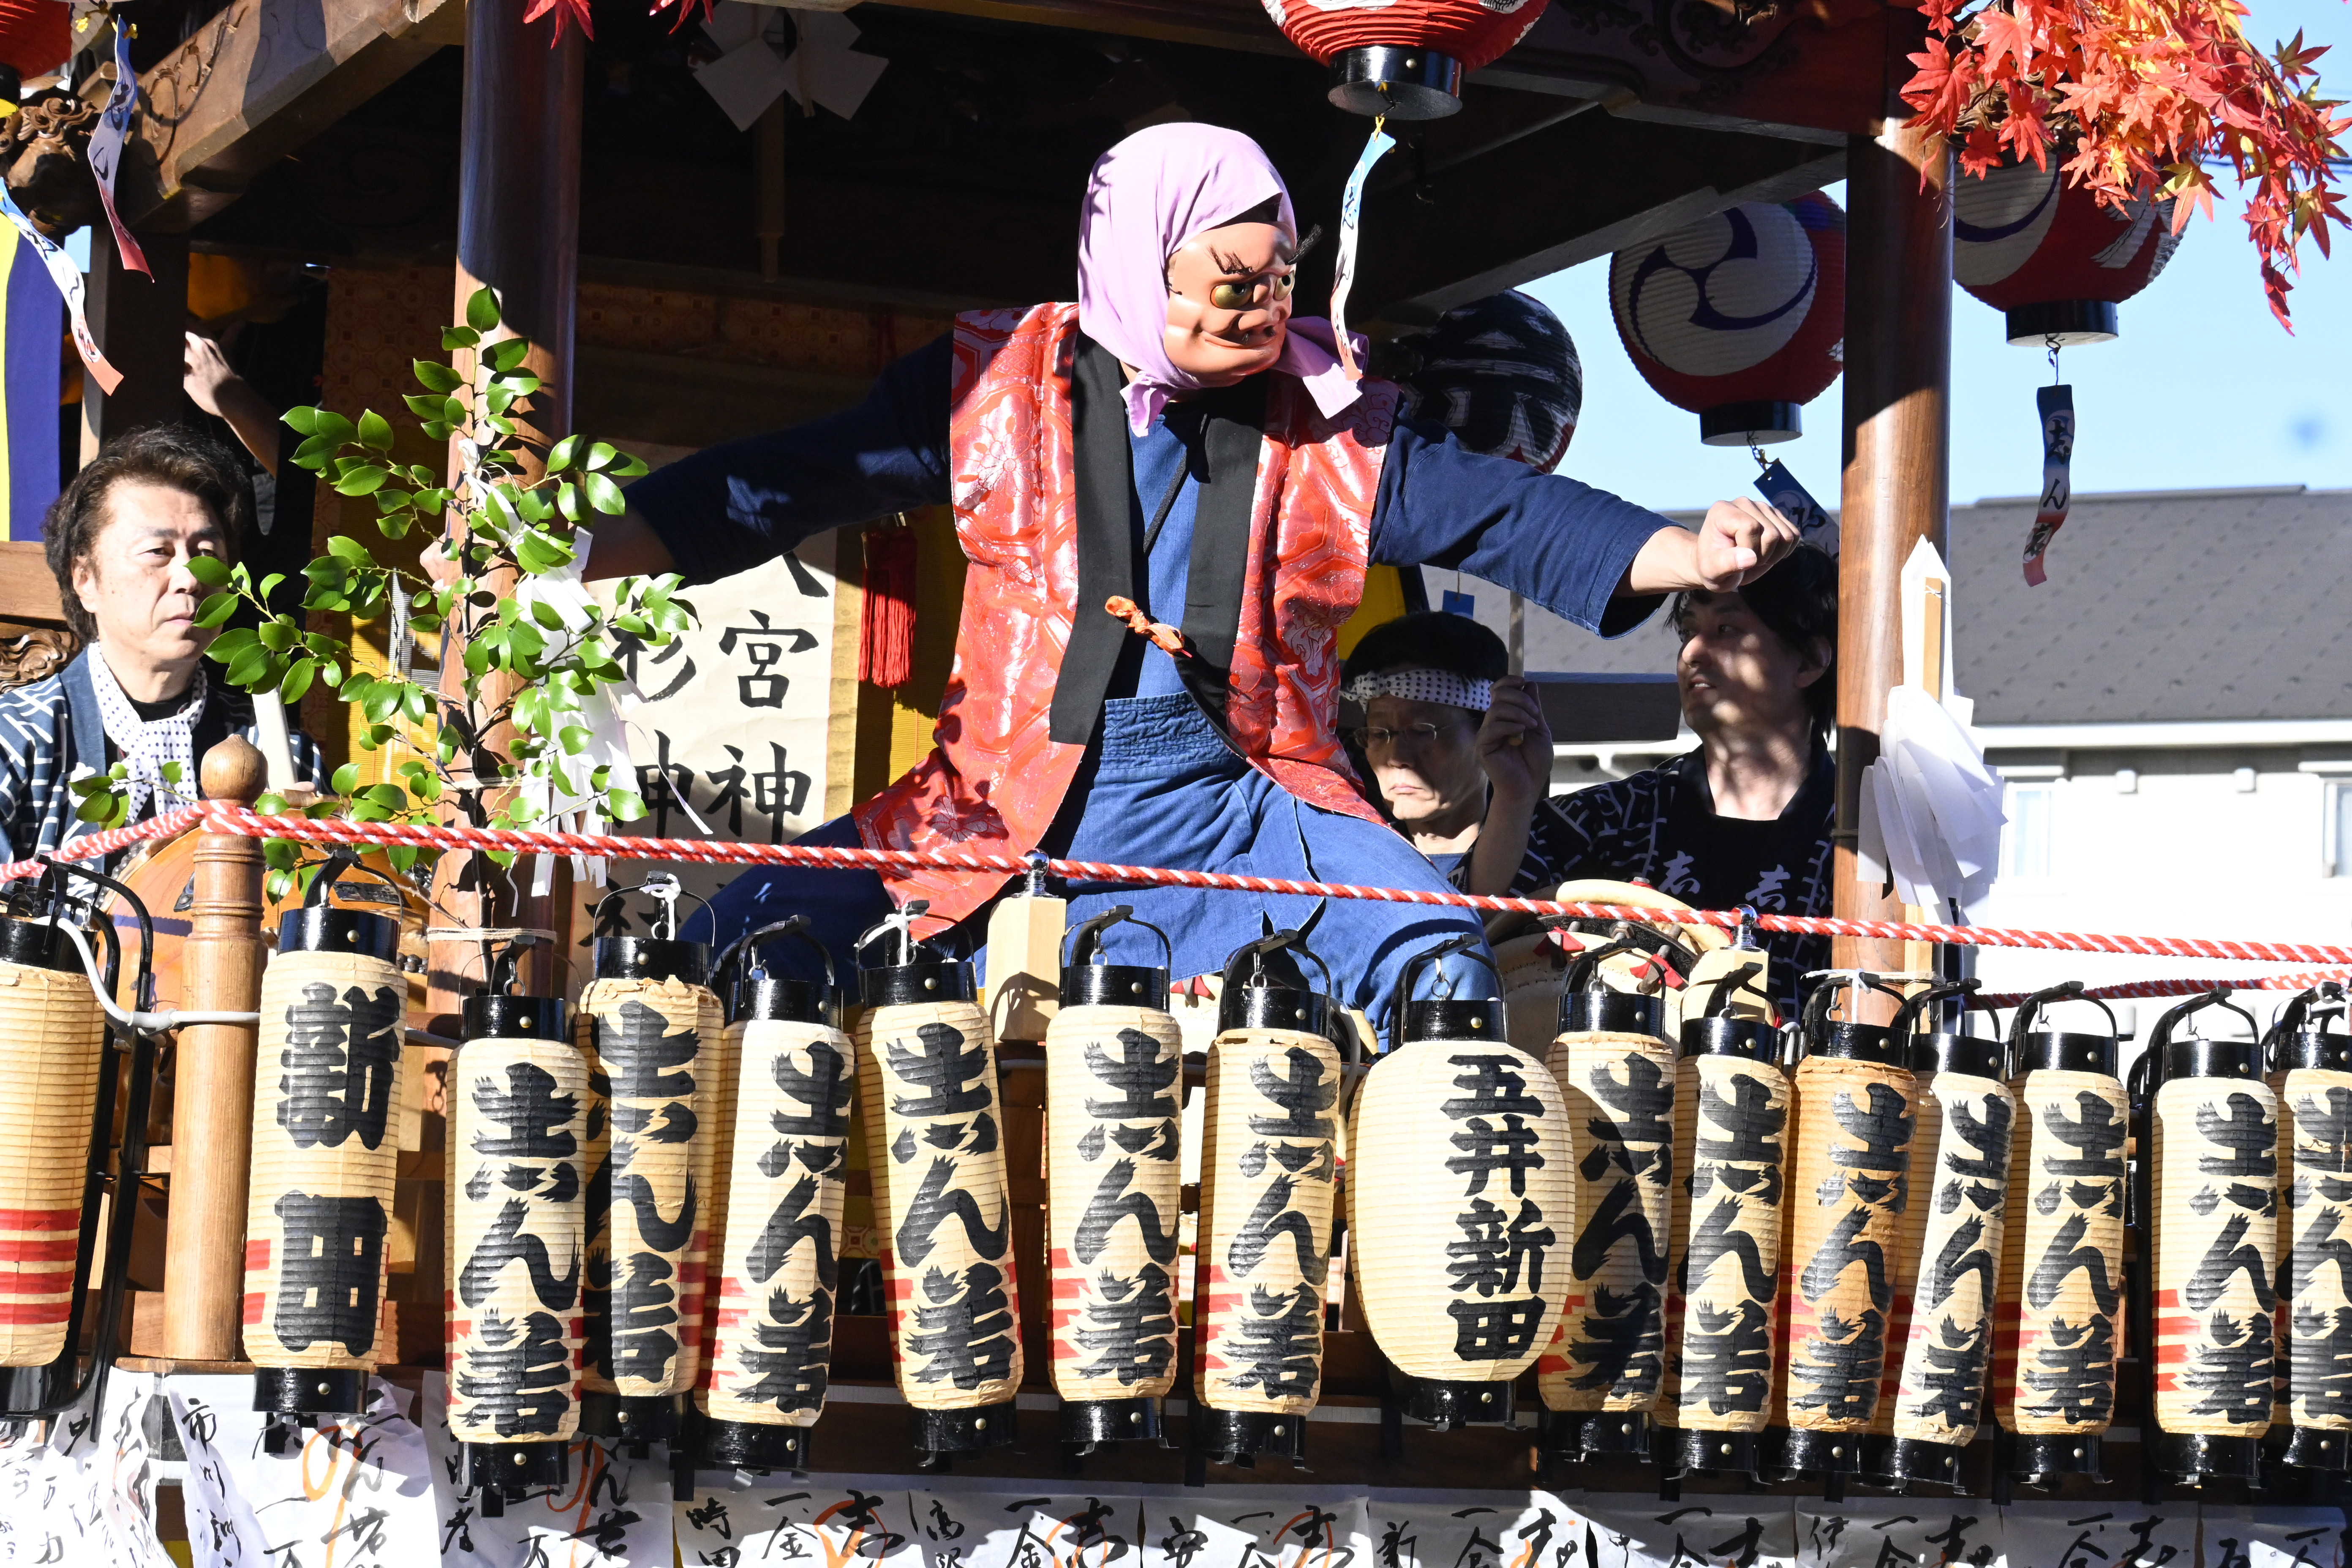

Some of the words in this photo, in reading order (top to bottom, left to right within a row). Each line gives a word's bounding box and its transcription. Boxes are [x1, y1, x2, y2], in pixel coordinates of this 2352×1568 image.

[274, 983, 400, 1356] 新田
[1440, 1054, 1555, 1361] 五井新田
